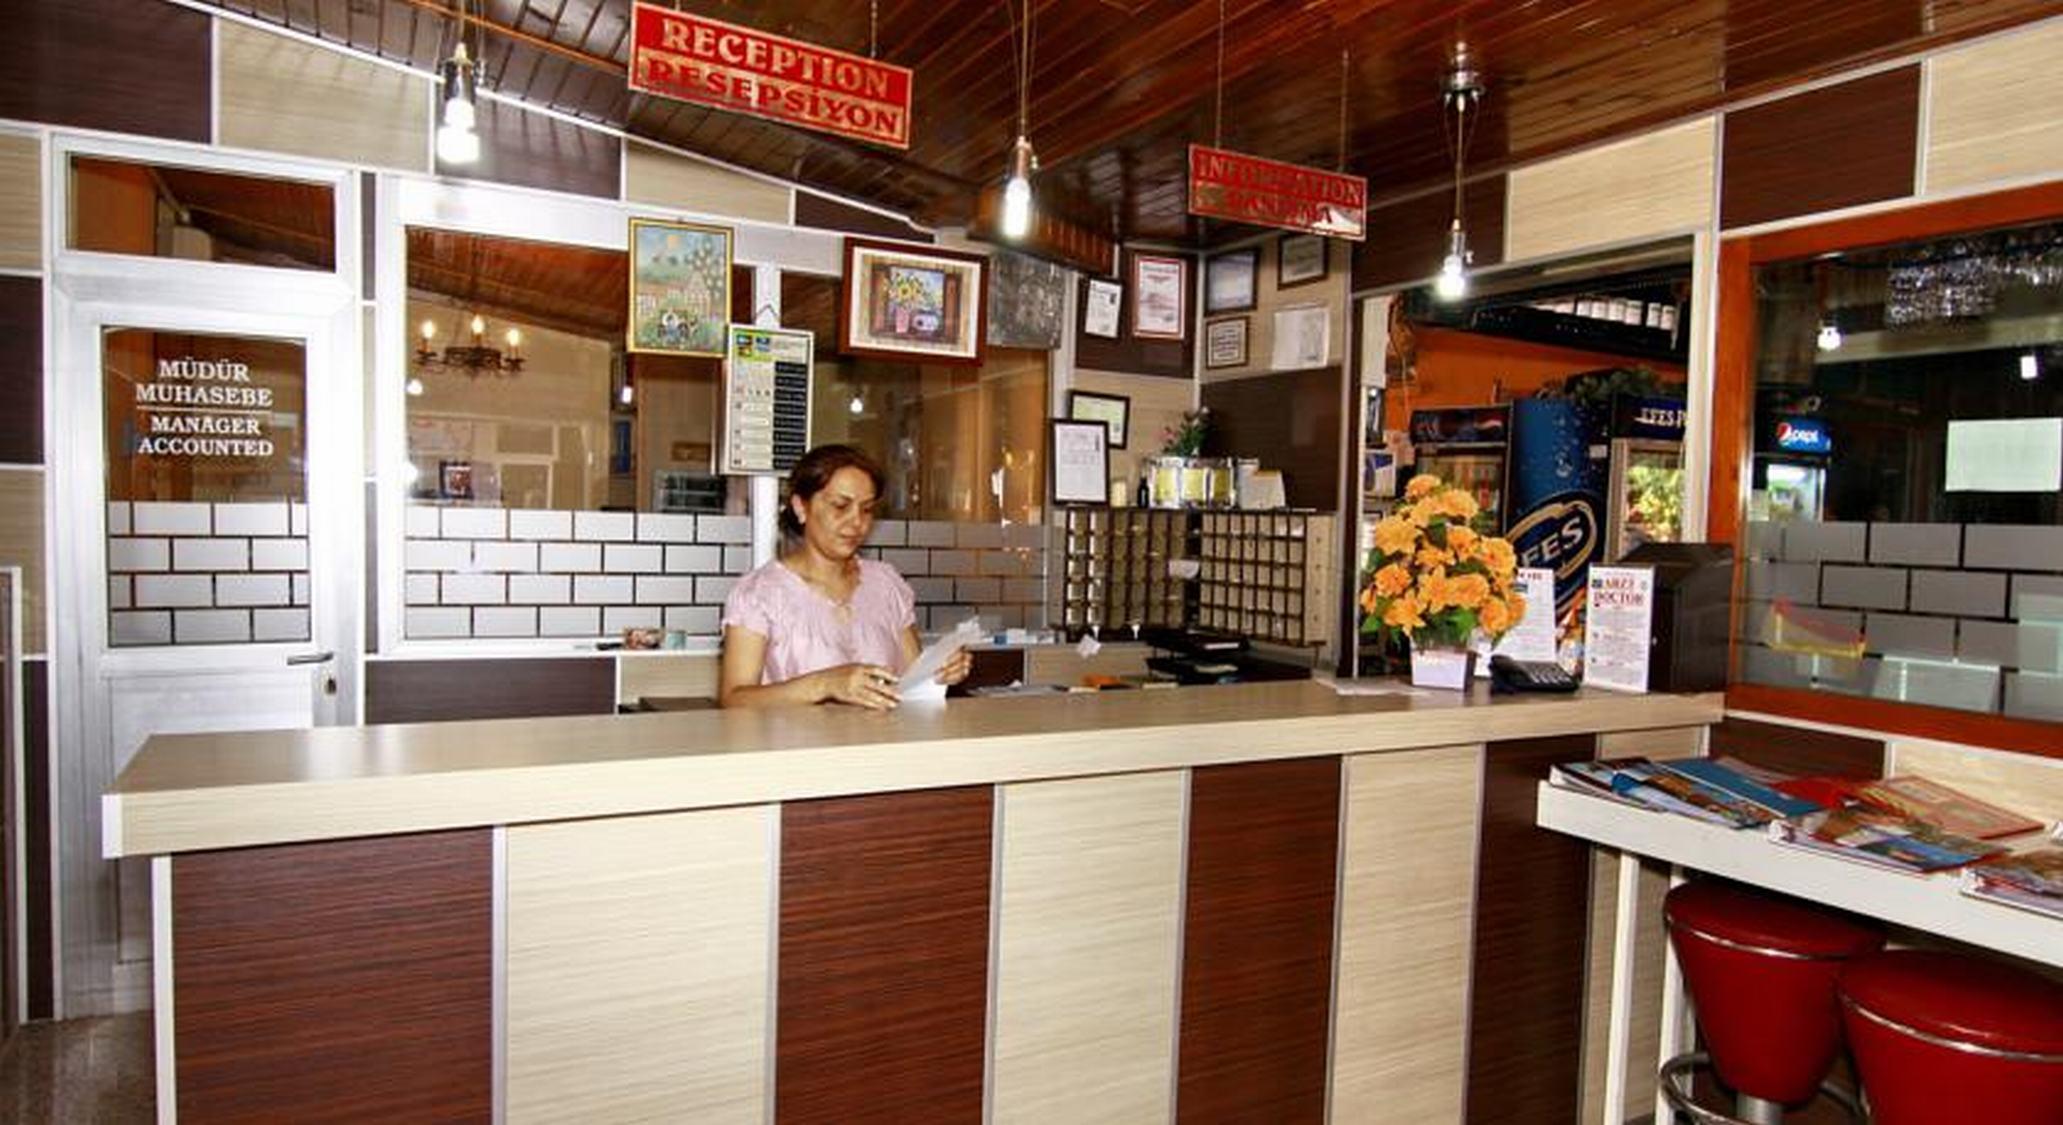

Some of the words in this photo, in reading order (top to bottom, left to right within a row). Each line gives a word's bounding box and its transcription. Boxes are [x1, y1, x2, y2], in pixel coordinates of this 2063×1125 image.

[662, 18, 890, 99] RECEPTION
[646, 56, 899, 137] RESEPSİYON
[158, 356, 250, 383] MÜDÜR
[135, 383, 274, 407] MUHASEBE
[150, 415, 262, 436] MANAGER
[137, 437, 274, 457] ACCOUNTED
[1520, 516, 1584, 568] FES
